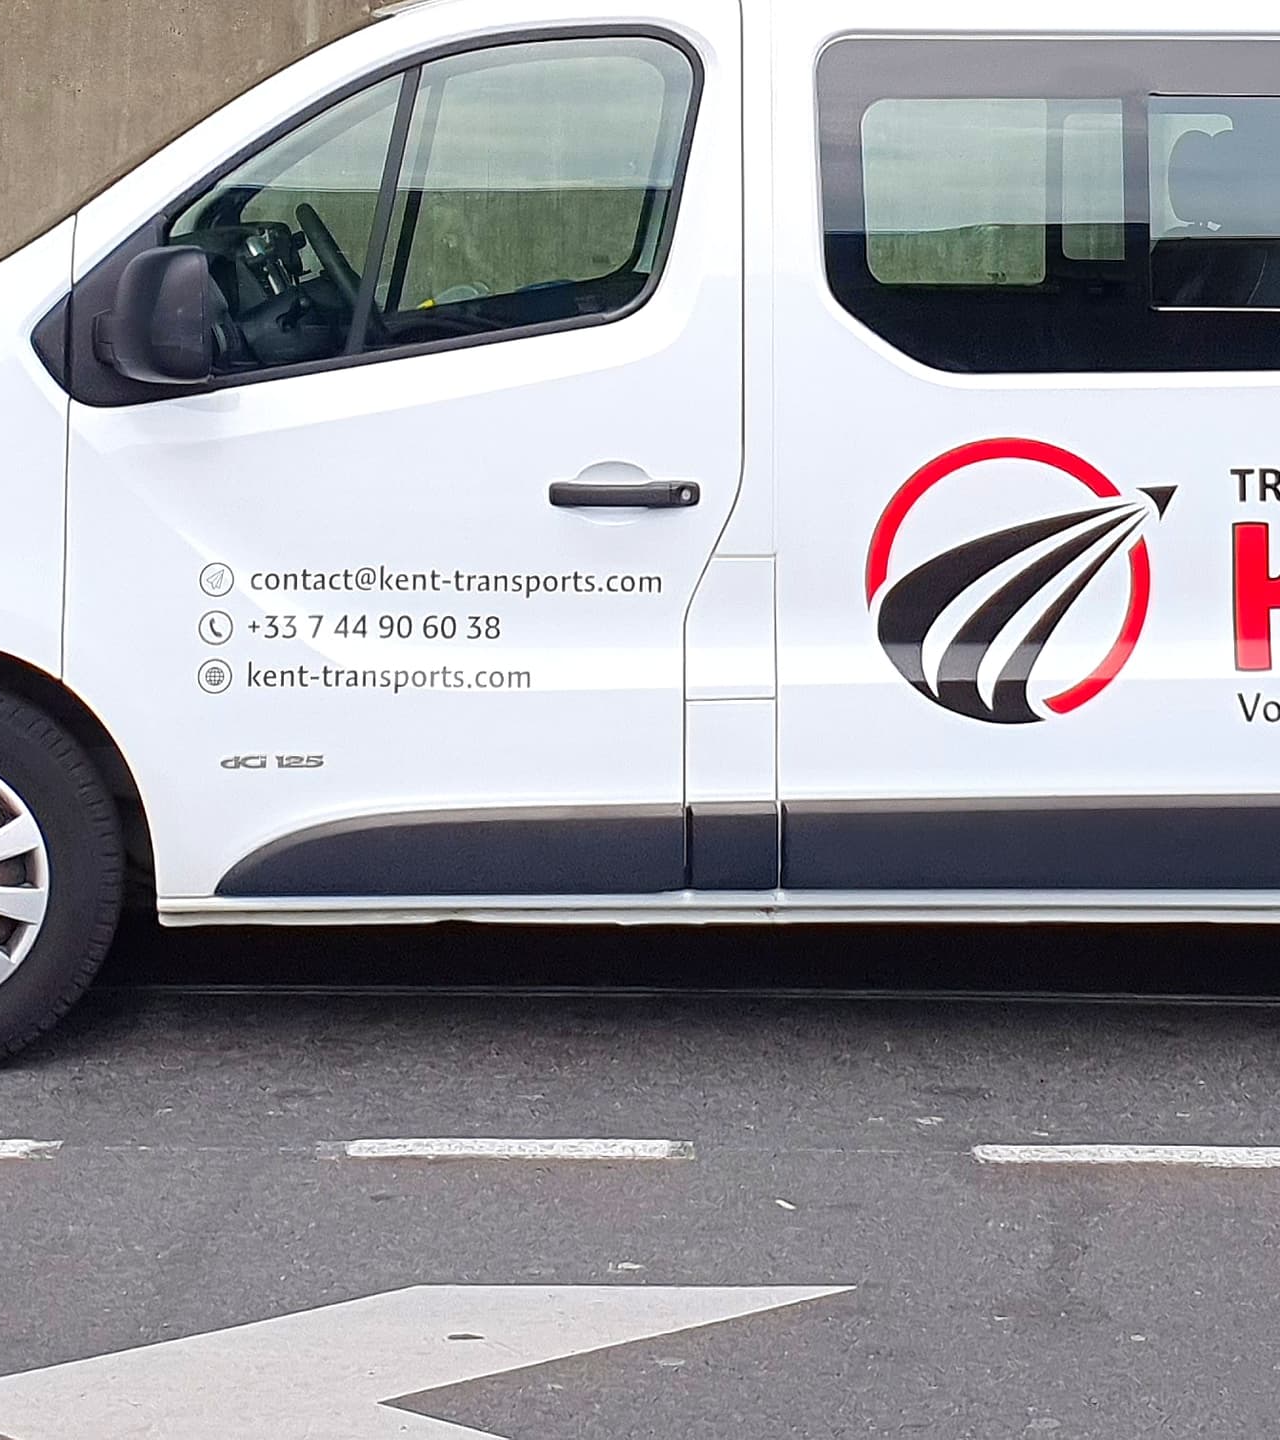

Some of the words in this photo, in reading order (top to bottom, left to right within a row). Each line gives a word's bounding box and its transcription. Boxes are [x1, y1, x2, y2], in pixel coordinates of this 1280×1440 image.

[251, 565, 661, 598] contact@kent-transports.com
[248, 616, 296, 639] +33
[308, 615, 323, 638] 7
[334, 615, 367, 638] 44
[379, 615, 412, 638] 90
[423, 615, 456, 639] 60
[467, 616, 500, 639] 38
[248, 661, 530, 694] kent-transports.com
[276, 755, 324, 768] 125
